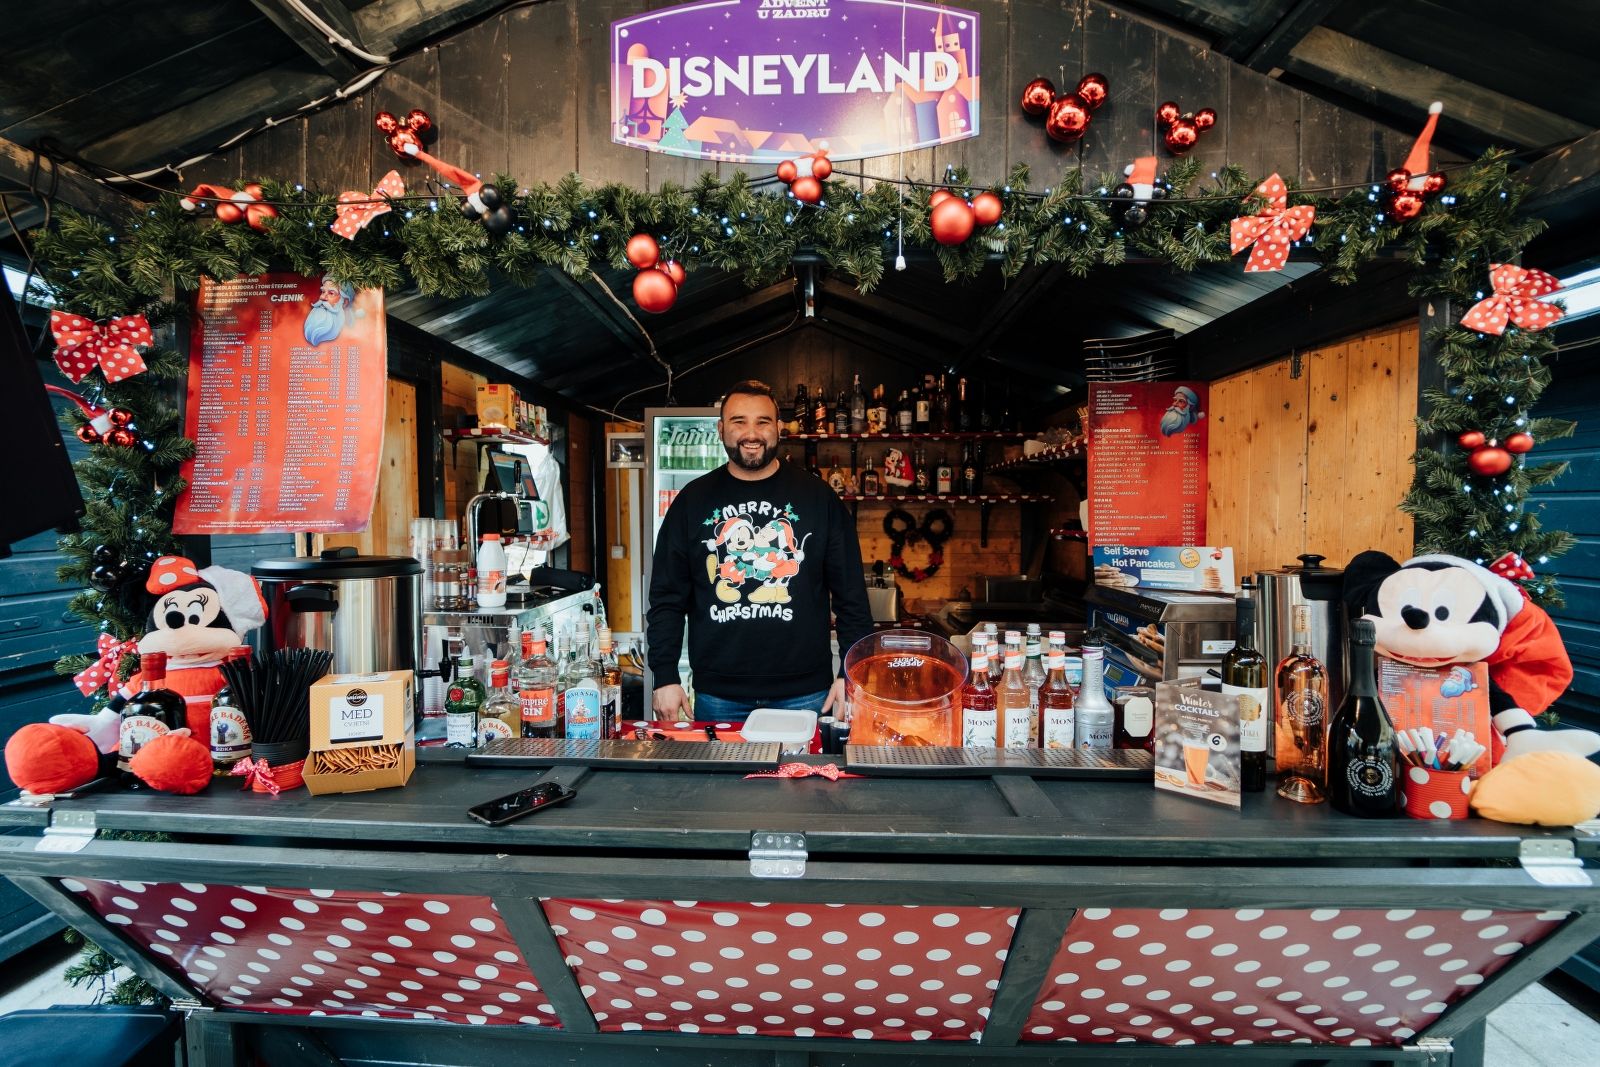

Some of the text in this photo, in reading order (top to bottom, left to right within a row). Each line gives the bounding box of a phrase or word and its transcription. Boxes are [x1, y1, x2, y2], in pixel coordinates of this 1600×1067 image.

[760, 0, 828, 8] ADVENT
[756, 8, 830, 19] U ZADRU
[632, 52, 960, 98] DISNEYLAND
[270, 293, 305, 302] CJENIK
[658, 425, 721, 449] Jamn
[722, 501, 783, 520] MERRY
[1104, 547, 1150, 556] Self Serve
[1112, 558, 1176, 569] Hot Pancakes
[709, 602, 794, 623] CHRISTMAS
[1180, 693, 1214, 709] Winter
[341, 708, 373, 720] MED
[523, 708, 543, 716] GIN
[1174, 704, 1220, 718] COCKTAILS
[1211, 735, 1221, 746] 6
